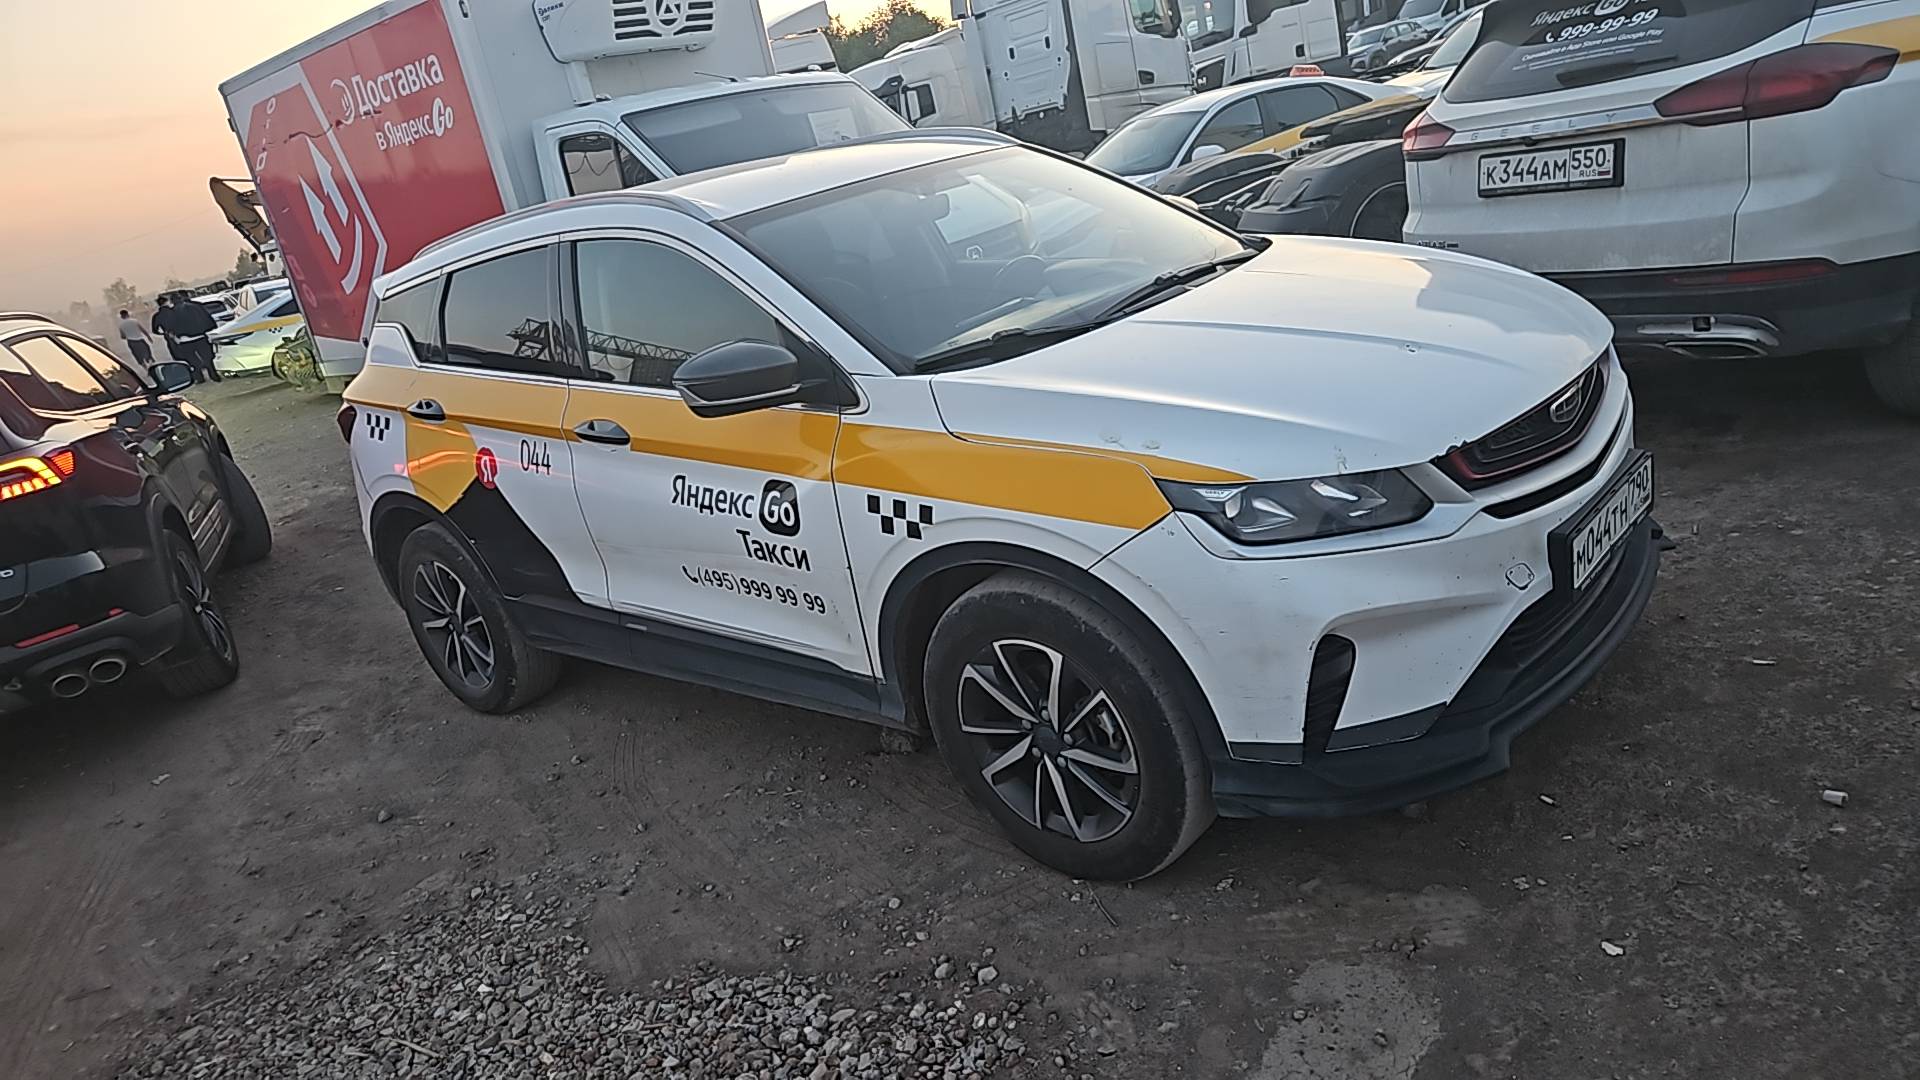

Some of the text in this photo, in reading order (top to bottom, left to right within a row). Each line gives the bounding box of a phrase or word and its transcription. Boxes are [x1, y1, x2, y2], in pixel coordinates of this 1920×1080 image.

[1530, 3, 1594, 26] Яндекс
[1557, 8, 1659, 42] 999-99-99
[351, 54, 445, 119] Доставка
[375, 96, 454, 151] в Яндекс Go
[1471, 112, 1616, 141] GEELY
[1571, 147, 1607, 170] 550
[1579, 169, 1597, 178] RUS
[520, 439, 551, 475] 044
[671, 474, 795, 527] Яндекс Go
[735, 528, 811, 572] Такси
[775, 585, 799, 607] 99
[802, 592, 826, 615] 99
